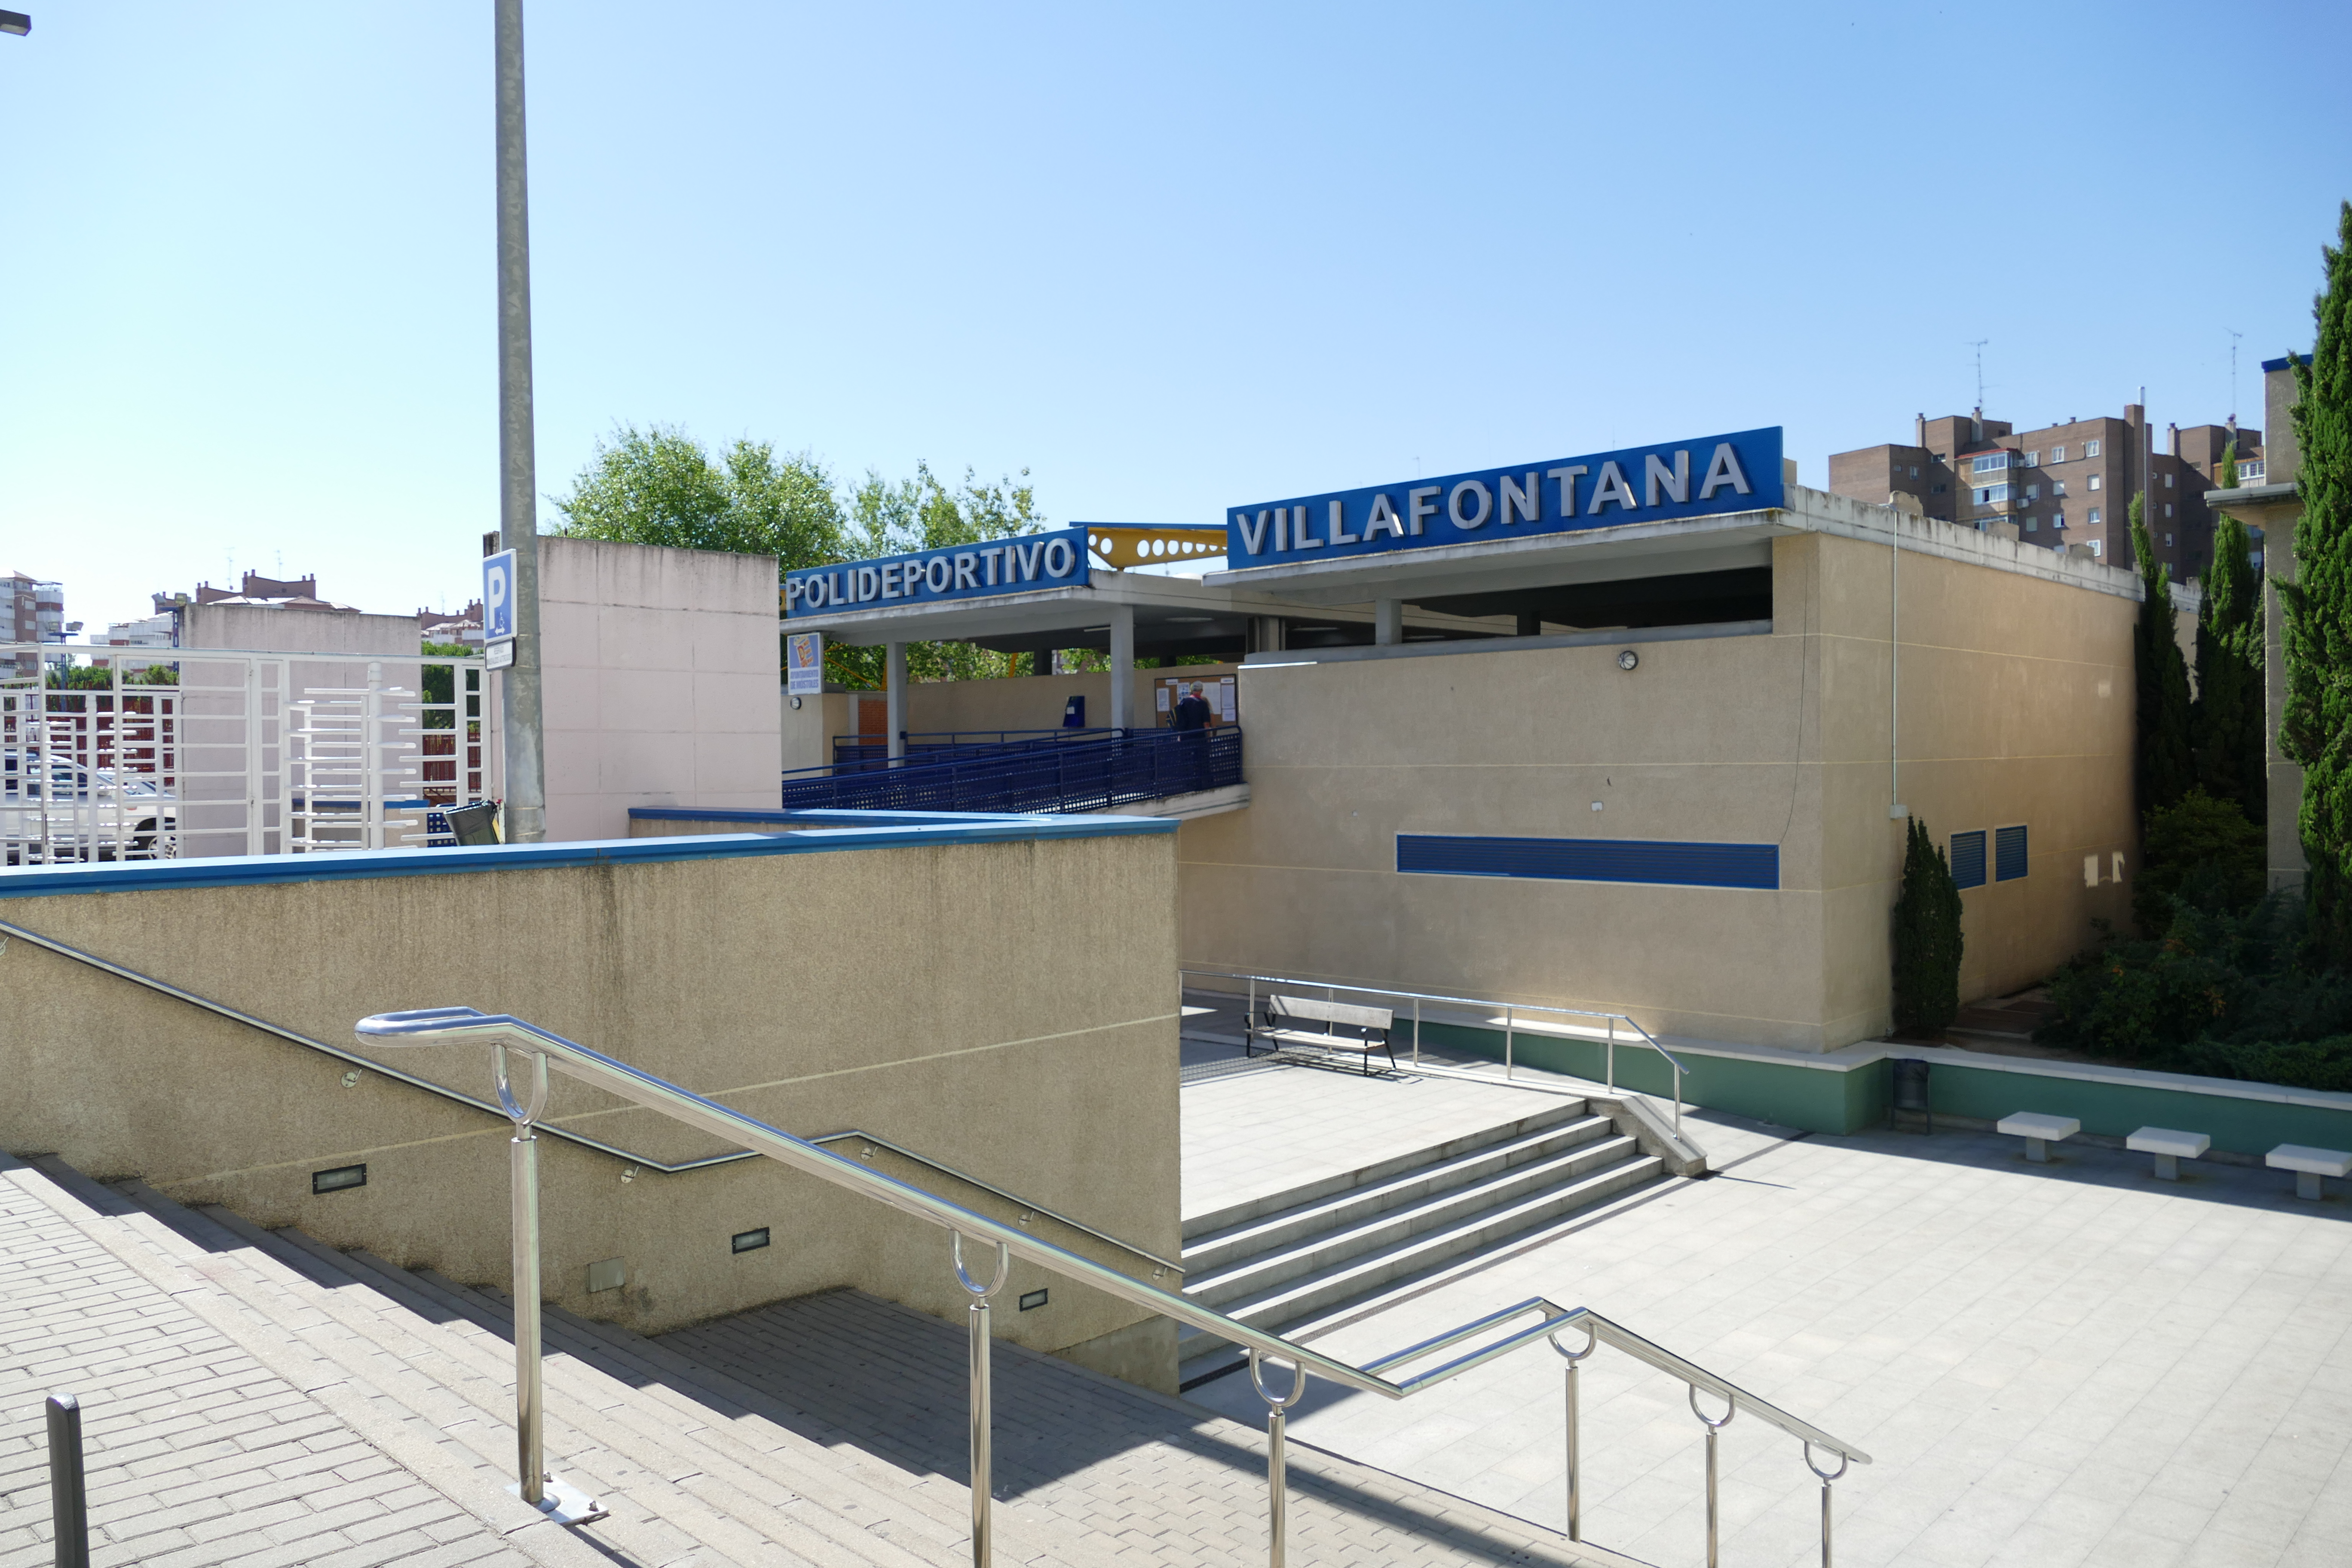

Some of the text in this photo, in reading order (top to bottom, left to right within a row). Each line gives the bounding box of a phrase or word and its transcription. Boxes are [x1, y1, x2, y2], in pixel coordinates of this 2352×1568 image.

[1236, 442, 1752, 555] VILLAFONTANA
[488, 566, 506, 630] P
[786, 538, 1075, 610] POLIDEPORTIVO
